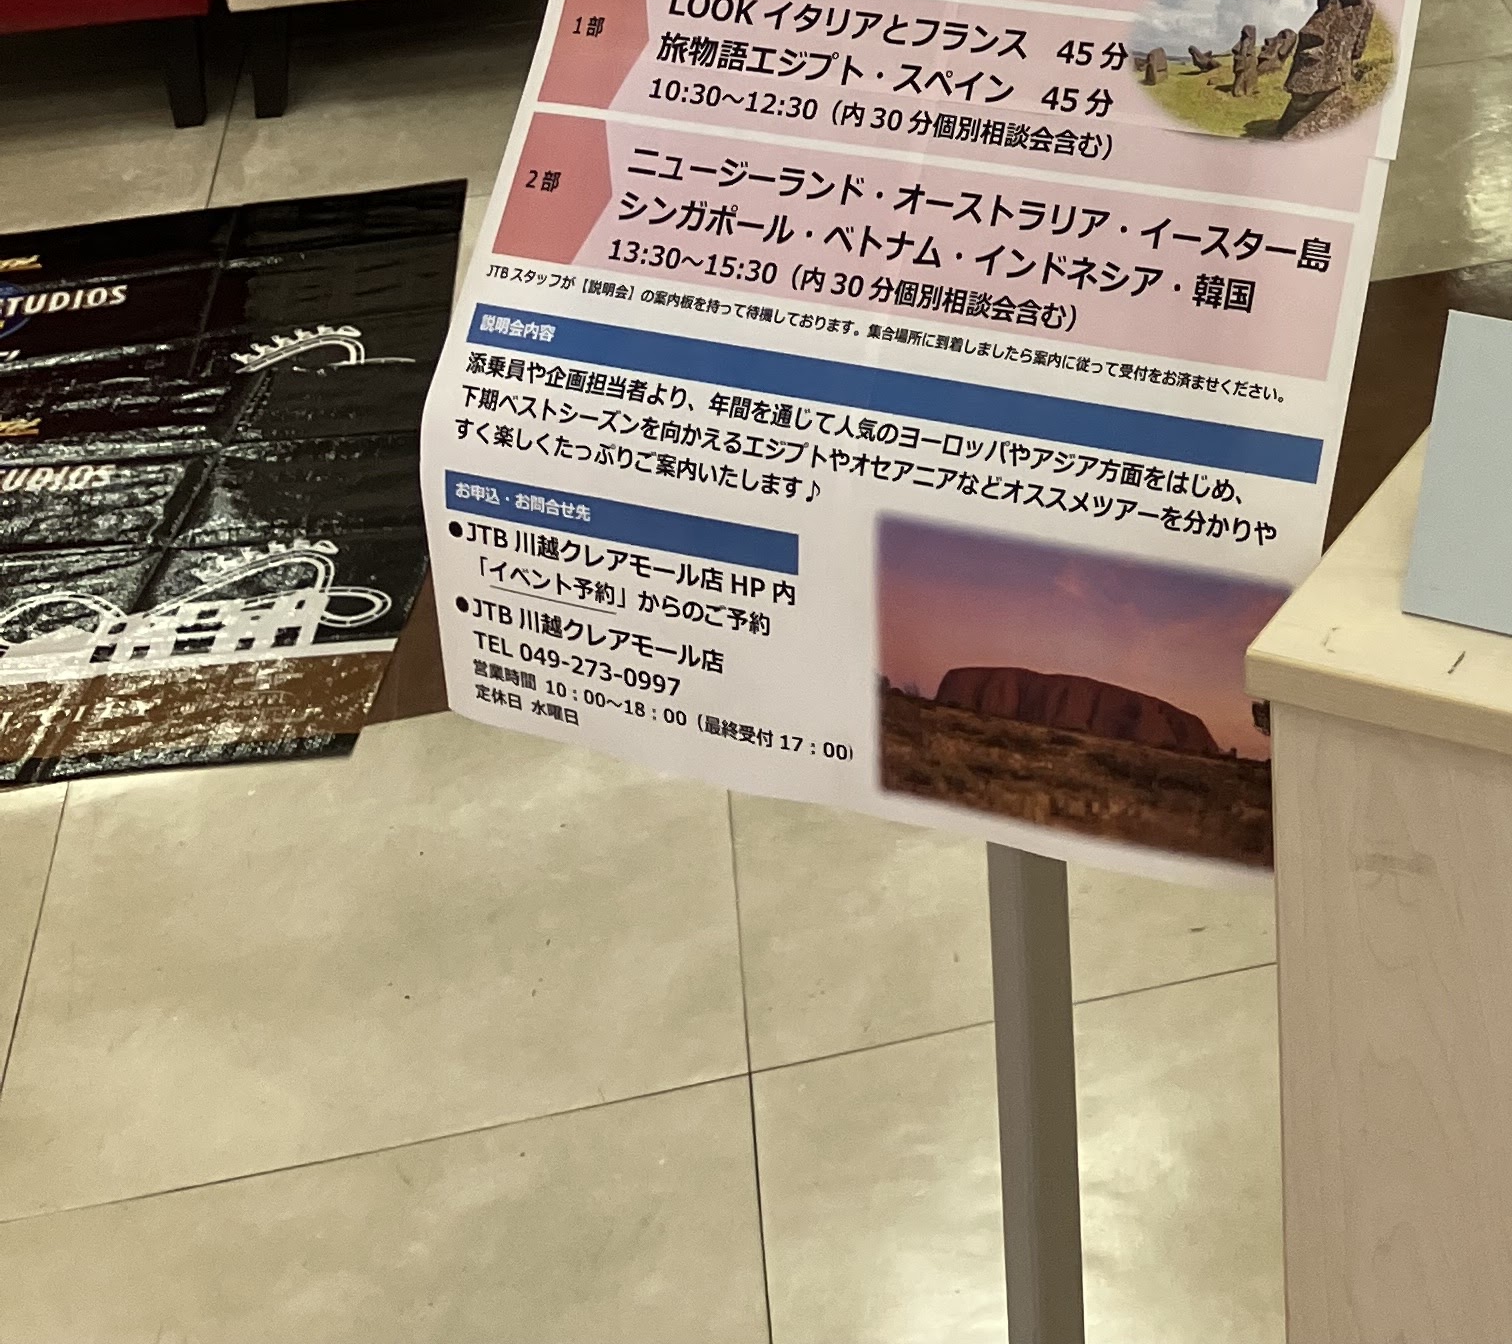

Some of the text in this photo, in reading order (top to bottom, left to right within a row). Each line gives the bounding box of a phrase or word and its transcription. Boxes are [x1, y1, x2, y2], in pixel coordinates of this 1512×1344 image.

[572, 15, 606, 38] 1部
[656, 32, 1016, 107] 旅物語エジプト・スペイン
[525, 170, 561, 193] 2部
[627, 147, 1333, 274] ニュージーランド・オーストラリア・イースター島
[617, 192, 1258, 313] シンガポール・ベトナム・インドネシア・韓国
[0, 284, 129, 318] TUDIOS
[480, 313, 556, 344] 説明会内容
[465, 351, 1244, 507] 添乗員や企画担当者より、年間を通じて人気のヨーロッパやアジア方面をはじめ、
[461, 385, 1278, 547] 下期ベストシーズンを向かえるエジプトやオセアニアなどオススメツアーを分かりや
[454, 481, 592, 522] お申込・お問合せ先
[472, 658, 537, 691] 営業時間
[473, 629, 681, 697] TEL 049-273-0997
[475, 683, 580, 726] 定休日 水曜日
